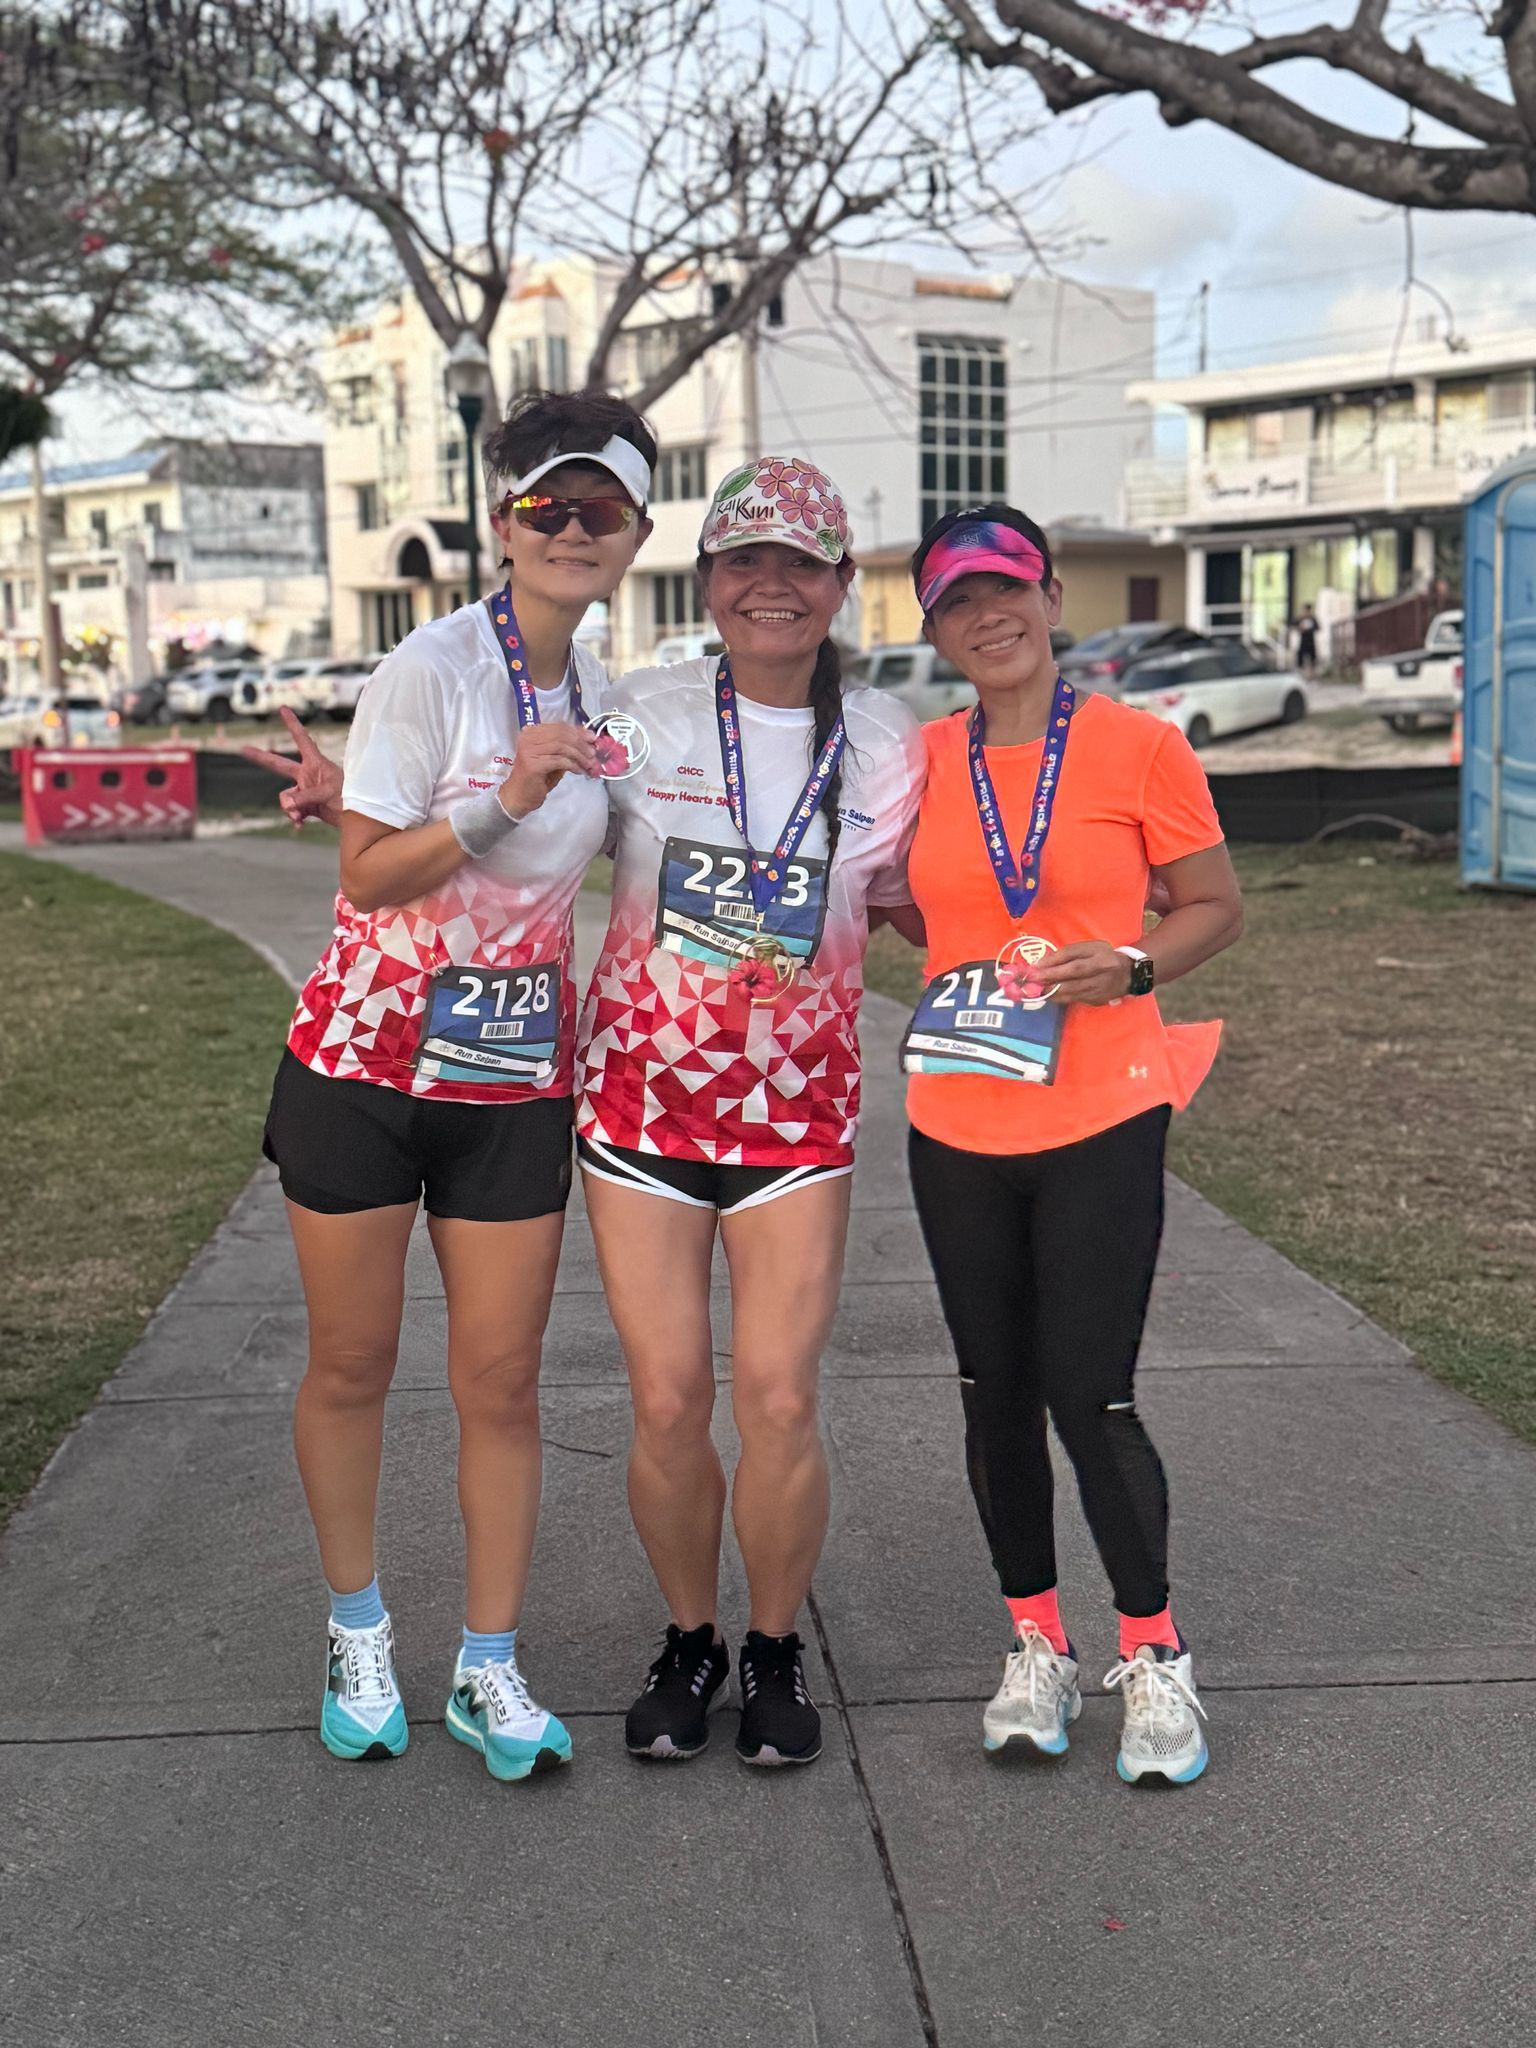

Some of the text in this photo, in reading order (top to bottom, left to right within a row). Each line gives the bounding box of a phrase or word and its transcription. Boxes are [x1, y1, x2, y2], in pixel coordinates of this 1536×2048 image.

[683, 850, 810, 907] 223
[693, 924, 710, 938] Run
[451, 972, 550, 1018] 2128
[931, 967, 1047, 1010] 212
[454, 1048, 473, 1060] Run
